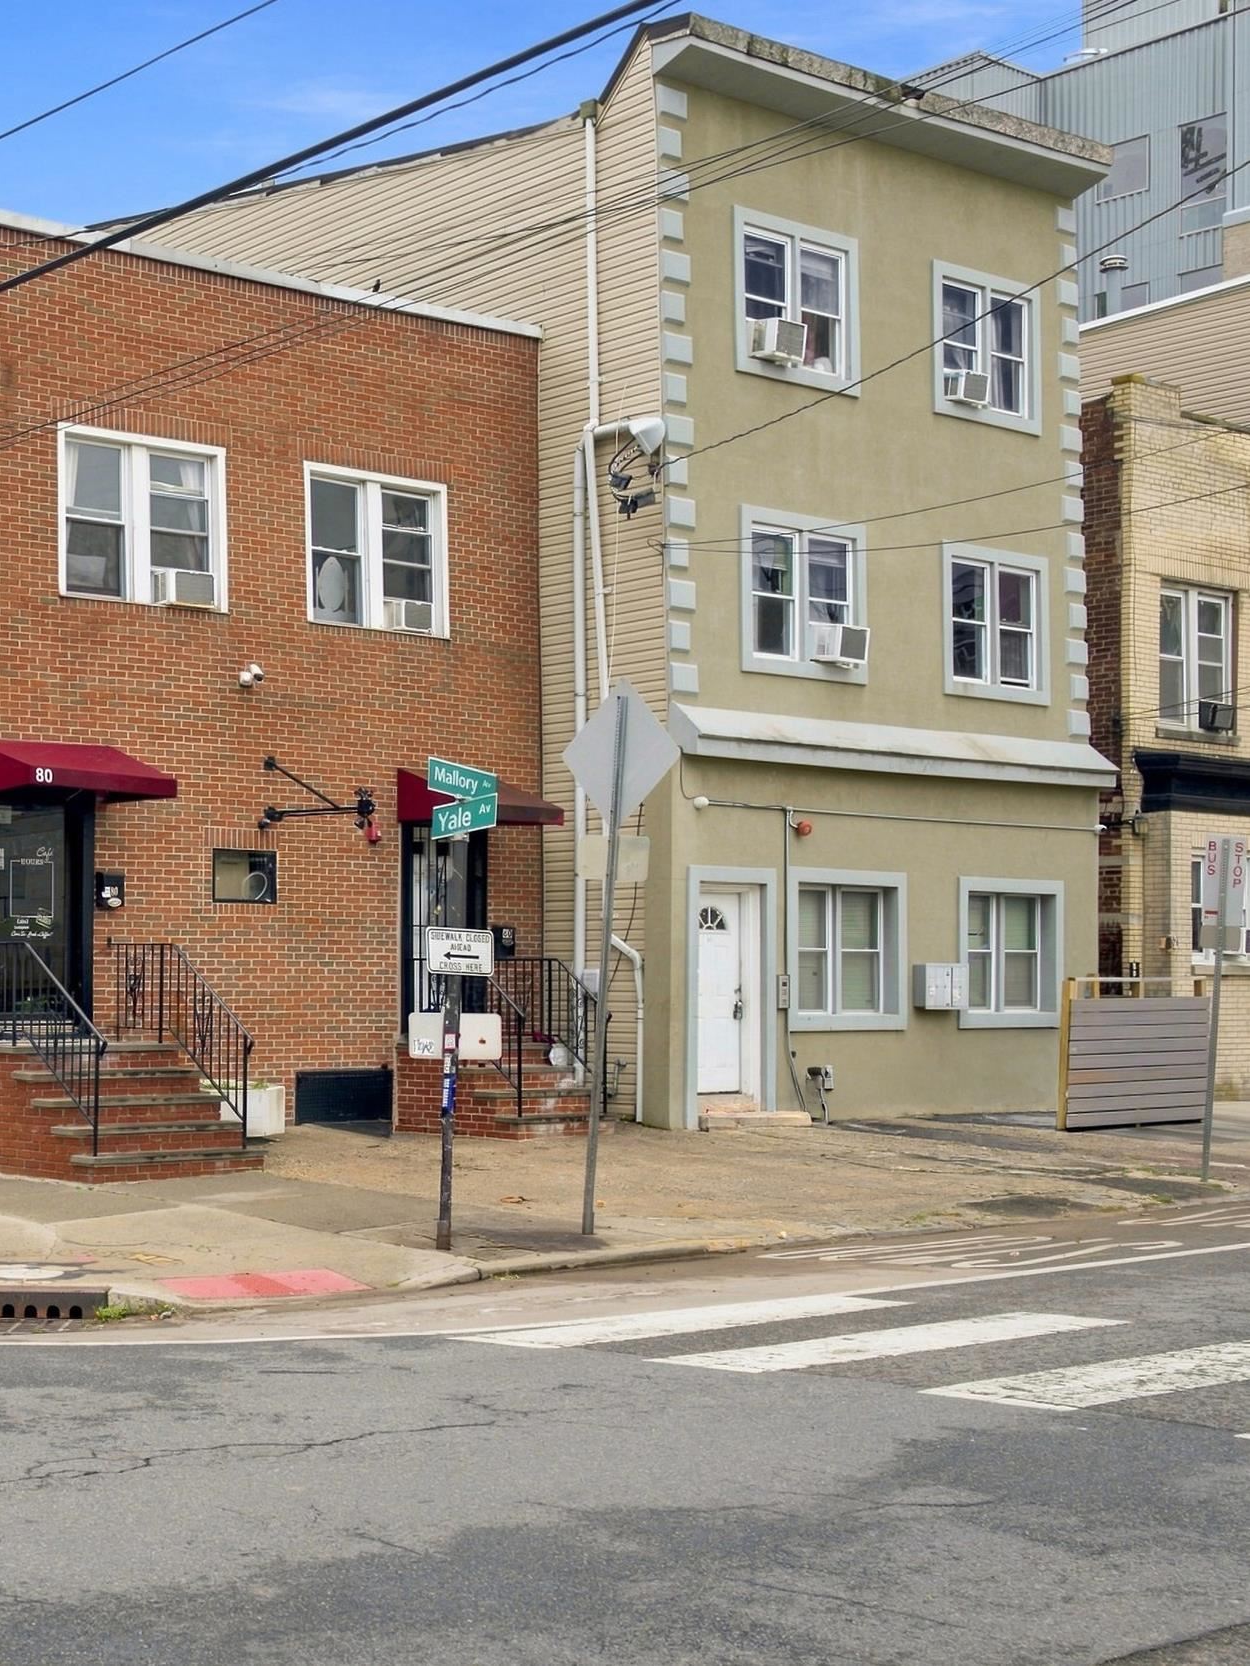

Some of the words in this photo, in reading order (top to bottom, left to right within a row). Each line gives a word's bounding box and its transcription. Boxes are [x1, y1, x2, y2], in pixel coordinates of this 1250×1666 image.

[35, 768, 53, 783] 80
[434, 766, 478, 795] Mallory
[438, 807, 471, 832] Yale
[479, 803, 491, 815] Av
[1207, 841, 1217, 875] BUS
[1233, 842, 1244, 888] STOP
[430, 931, 463, 942] SIDEWALK
[465, 934, 490, 944] CLOSED
[450, 943, 472, 952] AHEAD
[439, 961, 462, 971] CROSS
[465, 963, 483, 972] HERE
